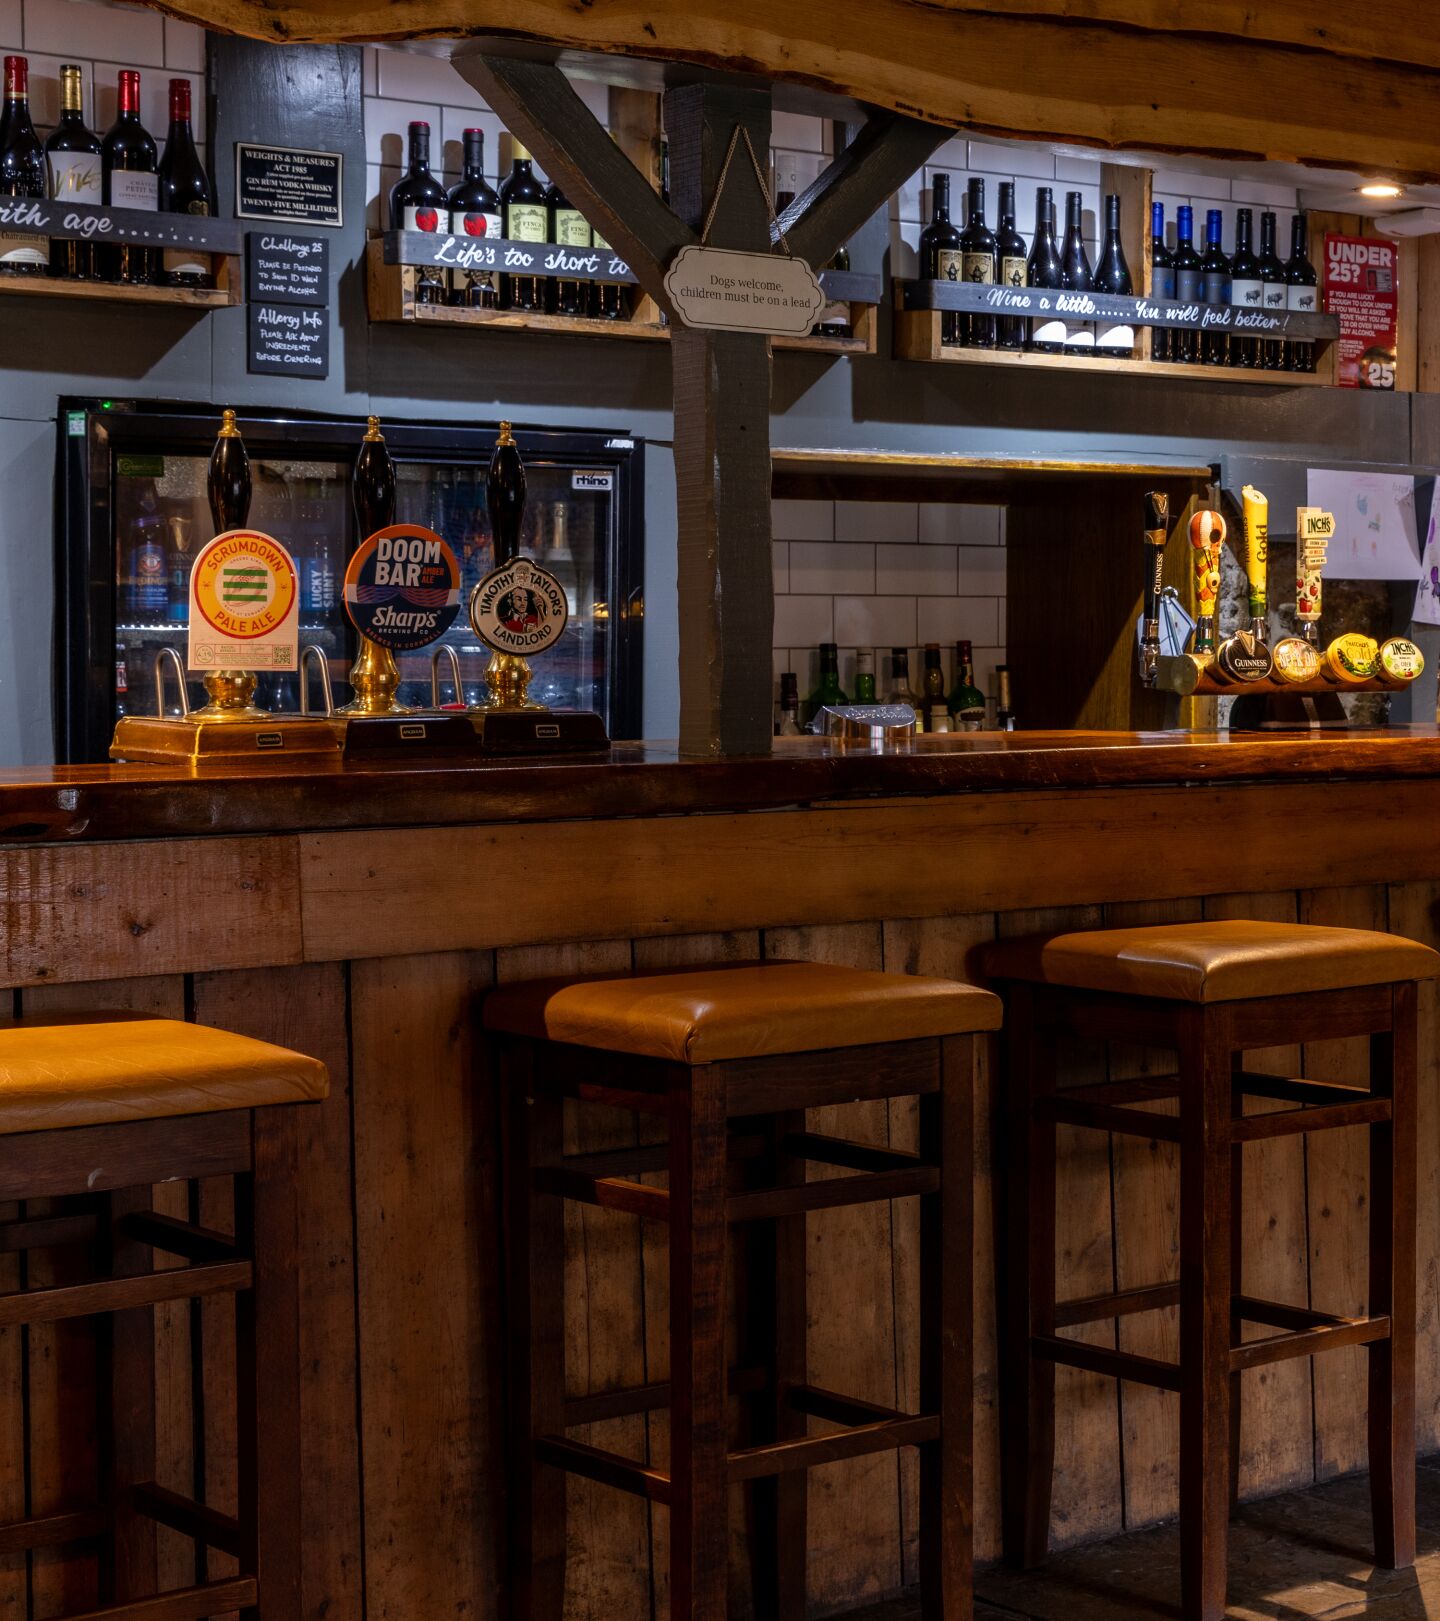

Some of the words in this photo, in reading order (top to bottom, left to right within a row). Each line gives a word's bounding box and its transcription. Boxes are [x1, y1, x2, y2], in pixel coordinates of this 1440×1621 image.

[245, 150, 283, 162] WEIGHTS
[284, 154, 290, 162] &
[292, 155, 335, 168] MEASURES
[274, 164, 290, 172] ACT
[292, 165, 307, 174] 1985
[246, 177, 260, 185] GIN
[261, 178, 278, 186] RUM
[279, 180, 304, 189] VODKA
[305, 183, 333, 192] WHISKY
[0, 201, 50, 227] ith
[242, 198, 292, 209] TWENTY-FIVE
[292, 202, 338, 213] MILLILITRES
[261, 237, 310, 258] Challenge
[312, 242, 322, 252] 25
[434, 237, 496, 267] Life's
[504, 248, 534, 266] too
[544, 250, 600, 272] short
[608, 256, 630, 274] to
[1328, 242, 1392, 267] UNDER
[291, 274, 299, 282] ID
[1328, 262, 1360, 282] 25?
[288, 286, 318, 295] ALCOHOL
[710, 274, 736, 288] Dogs
[738, 278, 784, 292] welcome,
[680, 286, 722, 300] children
[724, 291, 750, 304] must
[752, 293, 764, 304] be
[767, 296, 780, 306] on
[782, 298, 788, 306] a
[790, 296, 811, 308] lead
[1328, 298, 1352, 306] ENOUGH
[1360, 300, 1374, 308] LOOK
[1374, 302, 1392, 310] UNDER
[986, 288, 1031, 308] Wine
[1039, 297, 1050, 310] a
[1135, 301, 1160, 319] You
[1166, 305, 1199, 322] will
[1201, 308, 1230, 328] feel
[1348, 306, 1360, 314] WILL
[1368, 308, 1386, 316] ASKED
[257, 308, 300, 330] Allergy
[303, 311, 322, 328] Info
[1354, 314, 1368, 322] THAT
[1380, 316, 1391, 324] ARE
[1358, 322, 1372, 330] OVER
[1351, 328, 1376, 338] ALCOHOL
[1368, 362, 1394, 388] 25
[576, 472, 608, 486] rhino
[377, 538, 440, 564] DOOM
[1256, 524, 1268, 563] Gold
[207, 540, 285, 572] SCRUMDOWN
[374, 561, 420, 587] BAR
[422, 566, 445, 576] AMBER
[422, 576, 434, 584] ALE
[1154, 553, 1164, 594] GUINNESS
[312, 570, 322, 608] LUCKY
[323, 570, 334, 608] SAINT
[480, 572, 514, 616] TIMOTHY
[530, 572, 564, 616] TAYLOR'S
[214, 610, 246, 632] PALE
[251, 611, 276, 632] ALE
[372, 604, 438, 632] Sharp's
[493, 624, 551, 645] LANDLORD
[1346, 640, 1369, 648] THATCHERS
[1234, 658, 1268, 668] GUINNESS
[1278, 653, 1304, 669] NECK
[1304, 652, 1318, 667] OIL
[1346, 648, 1372, 660] Gold
